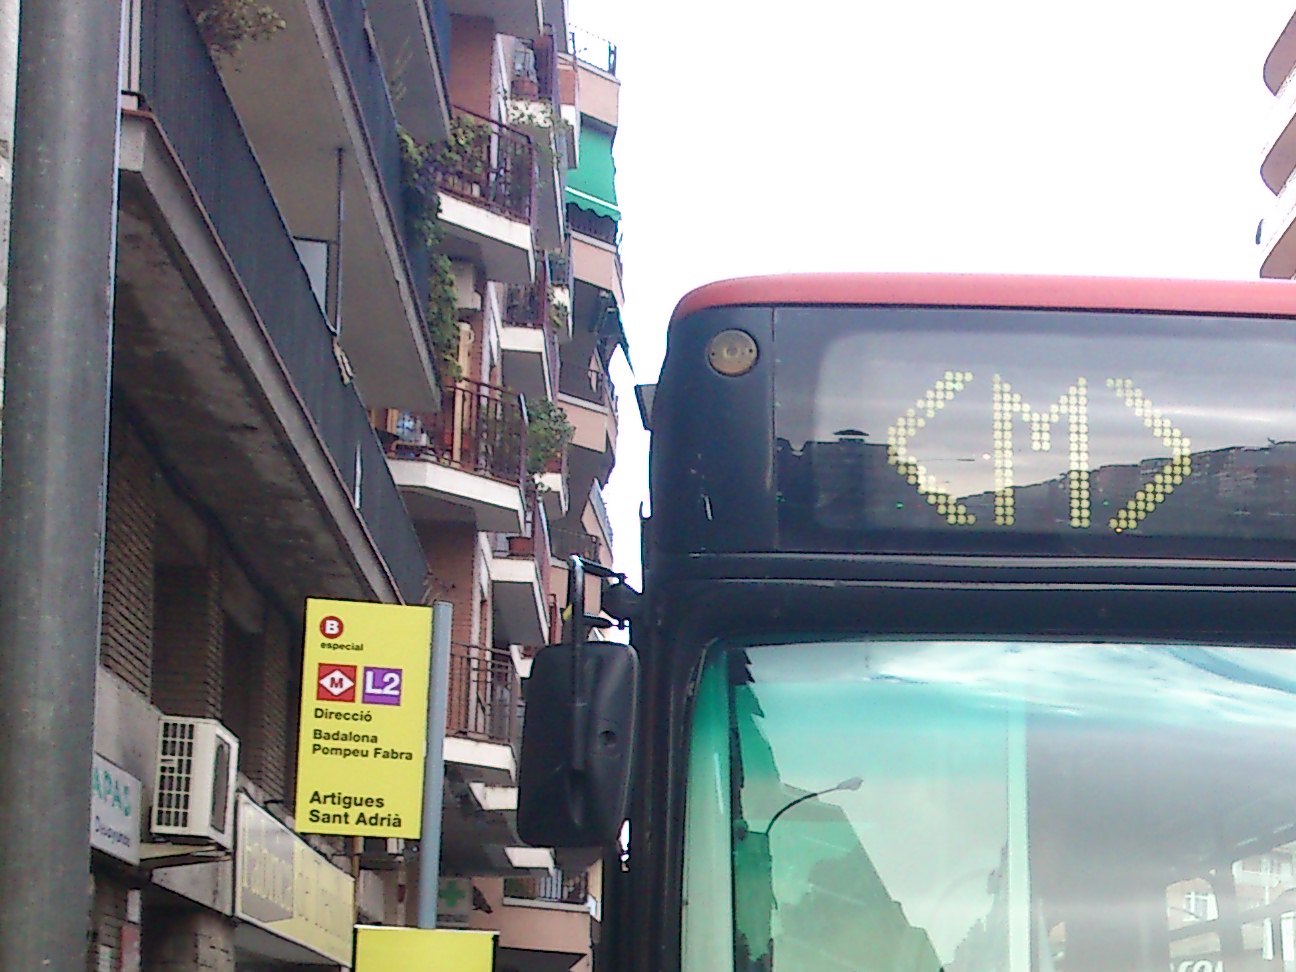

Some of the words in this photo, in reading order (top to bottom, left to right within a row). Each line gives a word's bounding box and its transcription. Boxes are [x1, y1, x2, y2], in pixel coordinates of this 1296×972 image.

[324, 619, 340, 635] B
[320, 641, 364, 652] especial
[329, 676, 344, 689] M
[365, 670, 401, 696] L2
[314, 708, 373, 723] Direcció
[312, 729, 378, 744] Badalona
[311, 743, 369, 759] Pompeu
[373, 747, 413, 761] Fabra
[309, 790, 385, 810] Artigues
[308, 809, 350, 825] Sant
[355, 812, 402, 828] Adrià
